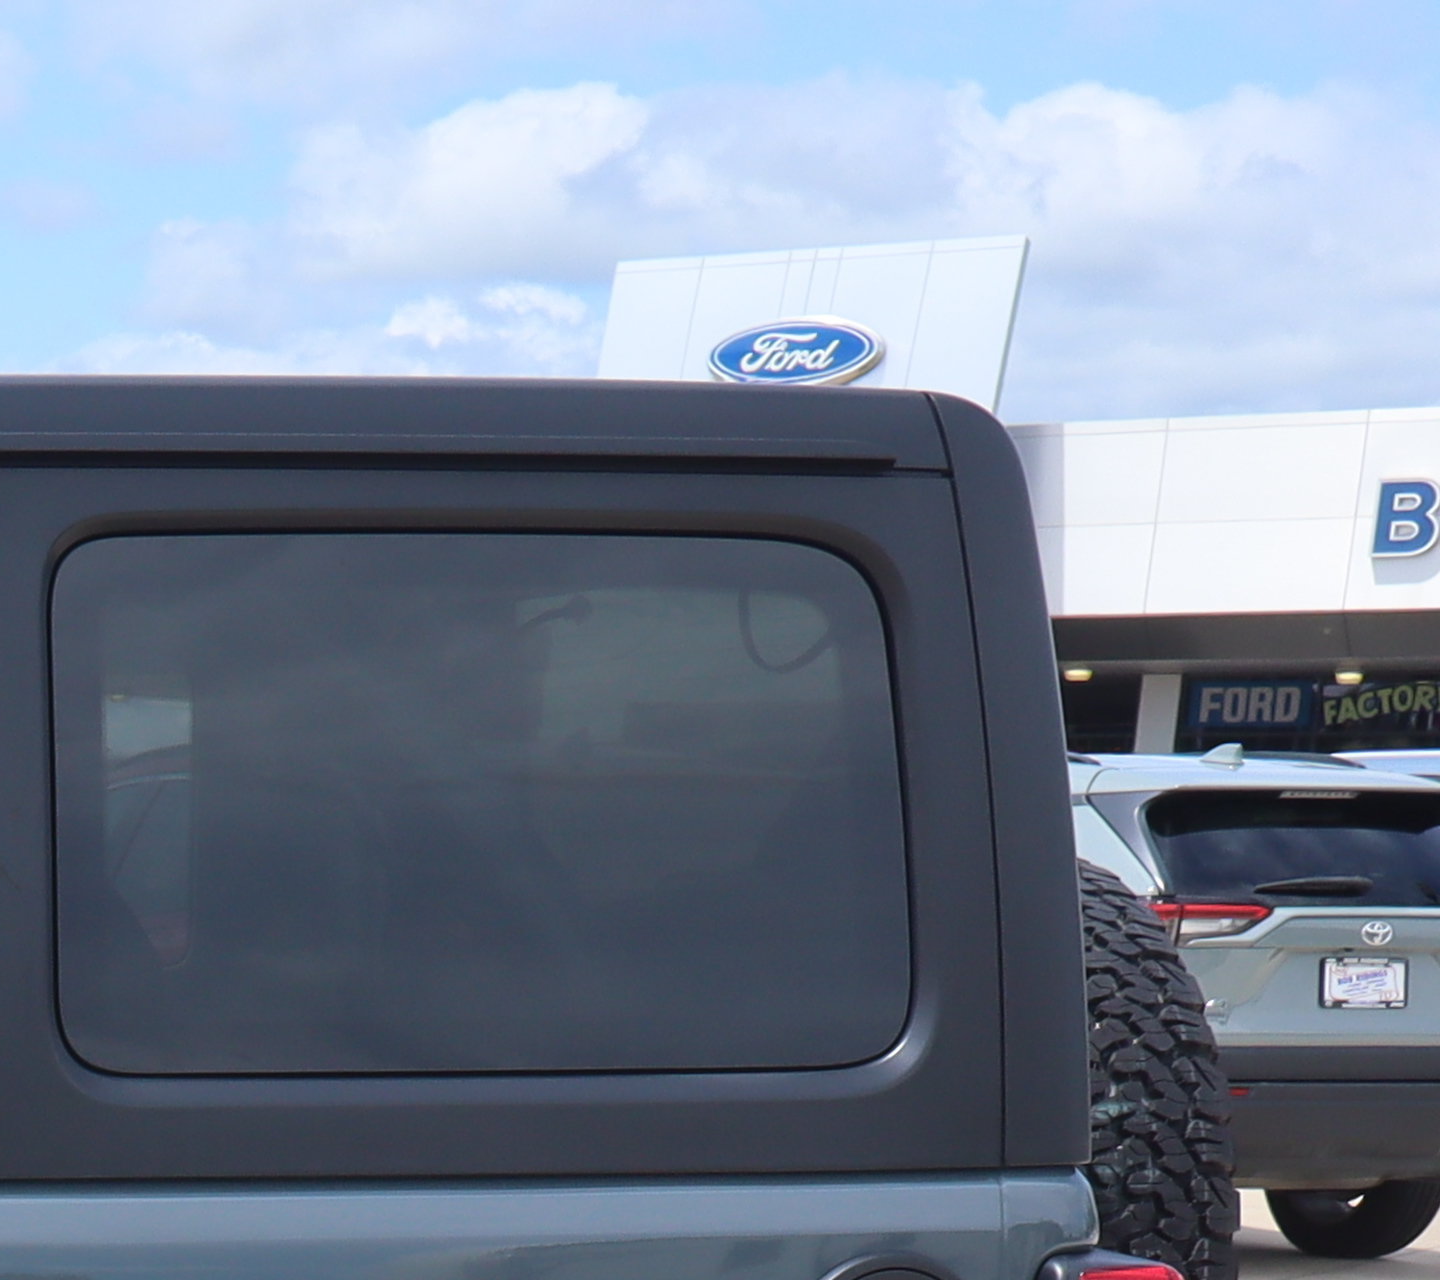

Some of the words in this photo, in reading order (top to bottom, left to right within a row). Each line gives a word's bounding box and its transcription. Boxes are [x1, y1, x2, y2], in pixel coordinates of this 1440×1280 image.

[740, 332, 840, 373] Ford
[1199, 686, 1302, 723] FORD
[1322, 684, 1440, 726] FACTOR
